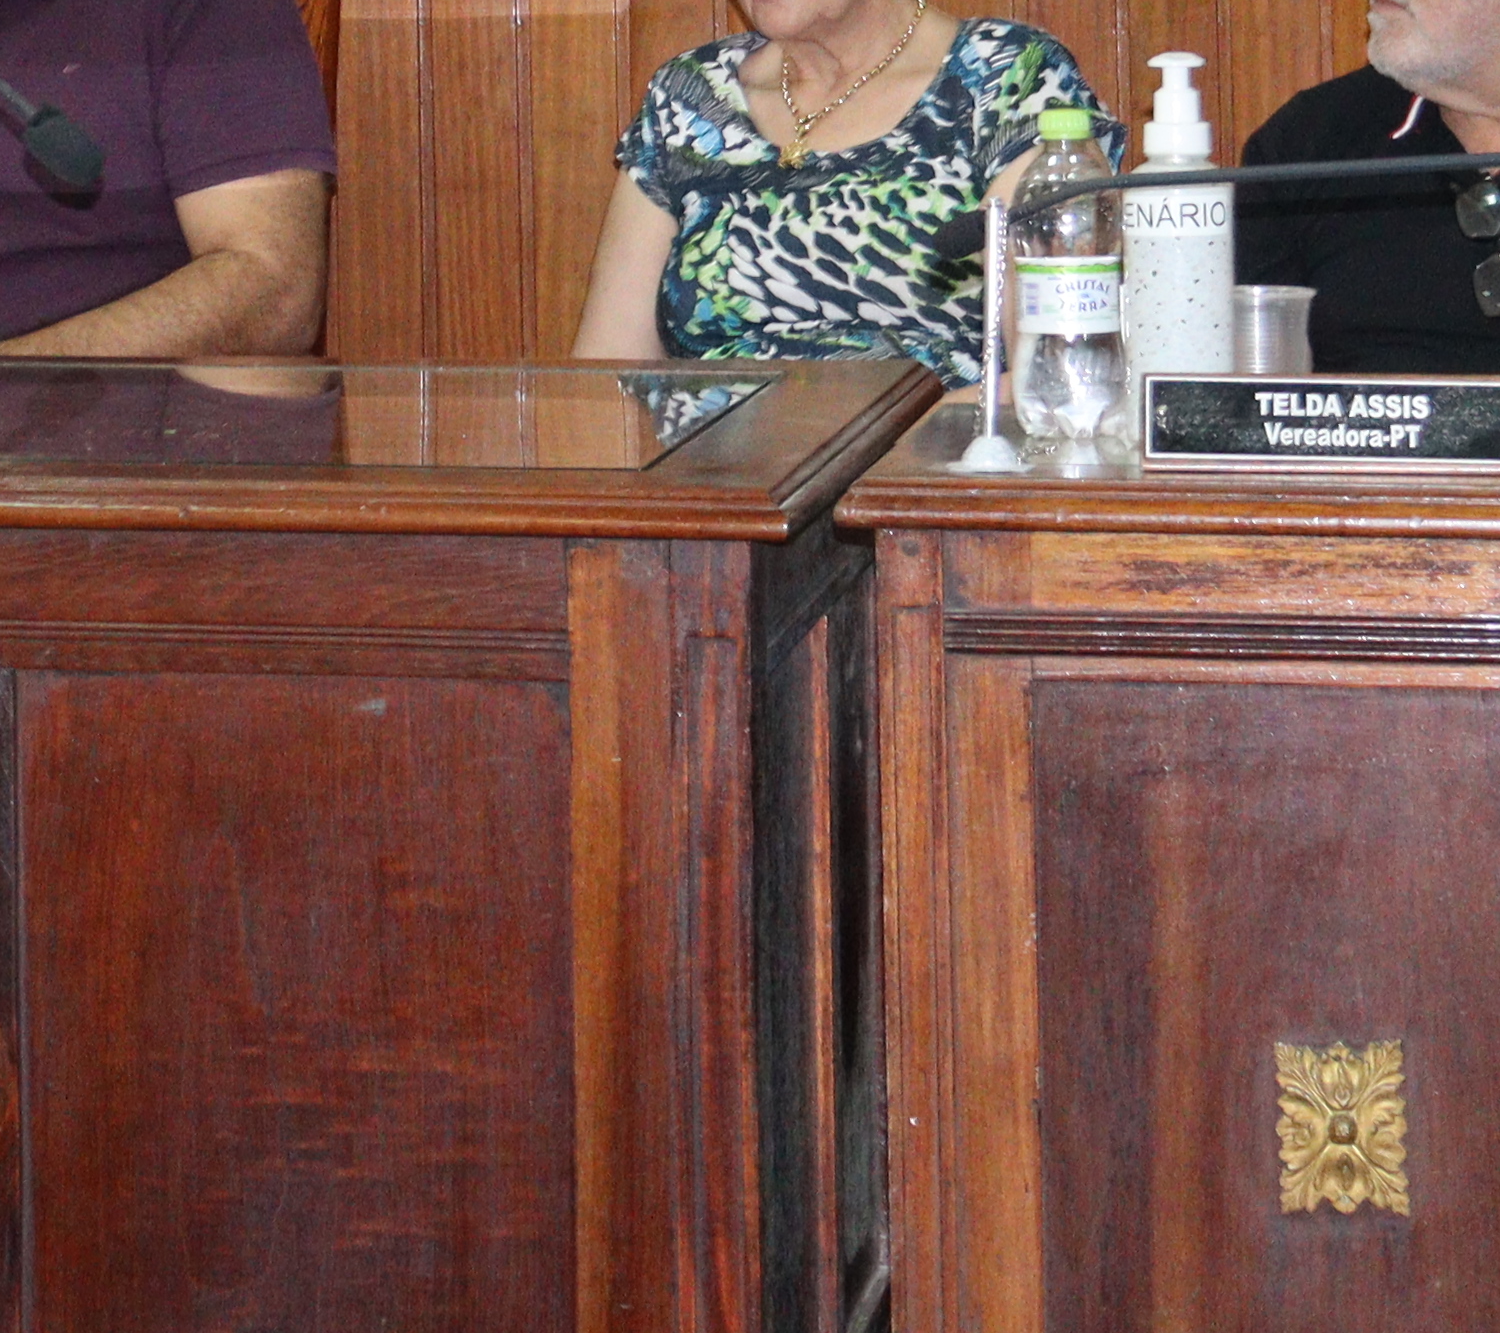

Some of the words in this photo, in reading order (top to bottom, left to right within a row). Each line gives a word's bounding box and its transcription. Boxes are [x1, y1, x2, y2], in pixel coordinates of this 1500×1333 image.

[1254, 392, 1344, 417] TELDA
[1348, 393, 1431, 419] ASSIS
[1263, 421, 1422, 449] Vereadora-PT
